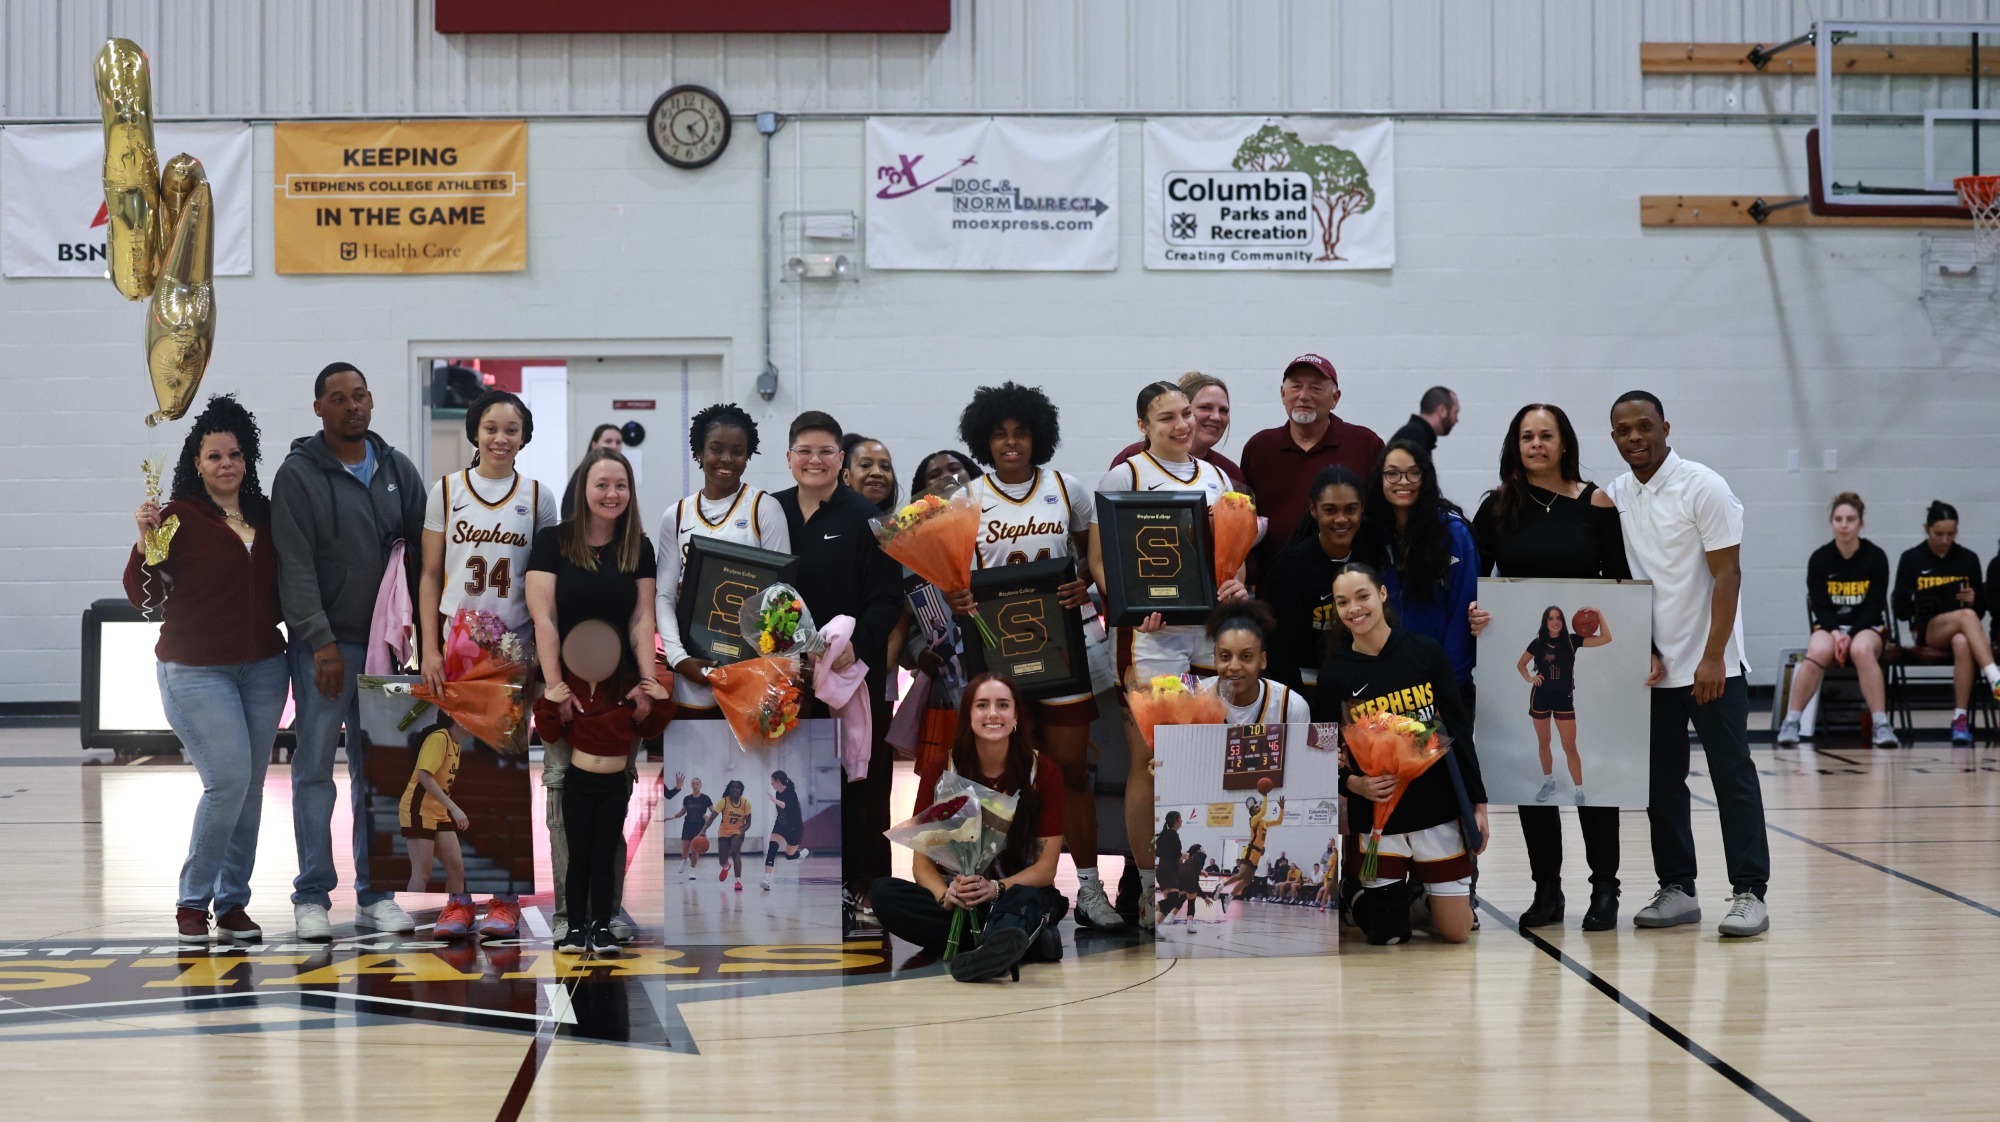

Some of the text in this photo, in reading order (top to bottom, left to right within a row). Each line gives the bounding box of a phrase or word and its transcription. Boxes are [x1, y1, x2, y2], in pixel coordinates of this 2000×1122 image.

[343, 148, 458, 167] KEEPING
[294, 179, 507, 192] STEPHENS COLLEGE ATHLETES
[952, 178, 1012, 193] DOC &
[1168, 178, 1307, 202] Columbia
[953, 197, 1012, 213] NORM
[1220, 206, 1307, 221] Parks and
[316, 206, 485, 226] IN THE GAME
[952, 218, 1093, 231] moexpress.com
[1210, 225, 1307, 240] Recreation
[363, 242, 417, 259] Health
[423, 243, 461, 259] Care
[1165, 249, 1313, 263] Creating Community
[452, 520, 528, 548] Stephens
[986, 515, 1064, 544] Stephens
[1136, 525, 1182, 578] S
[464, 555, 511, 598] 34
[998, 598, 1048, 657] S
